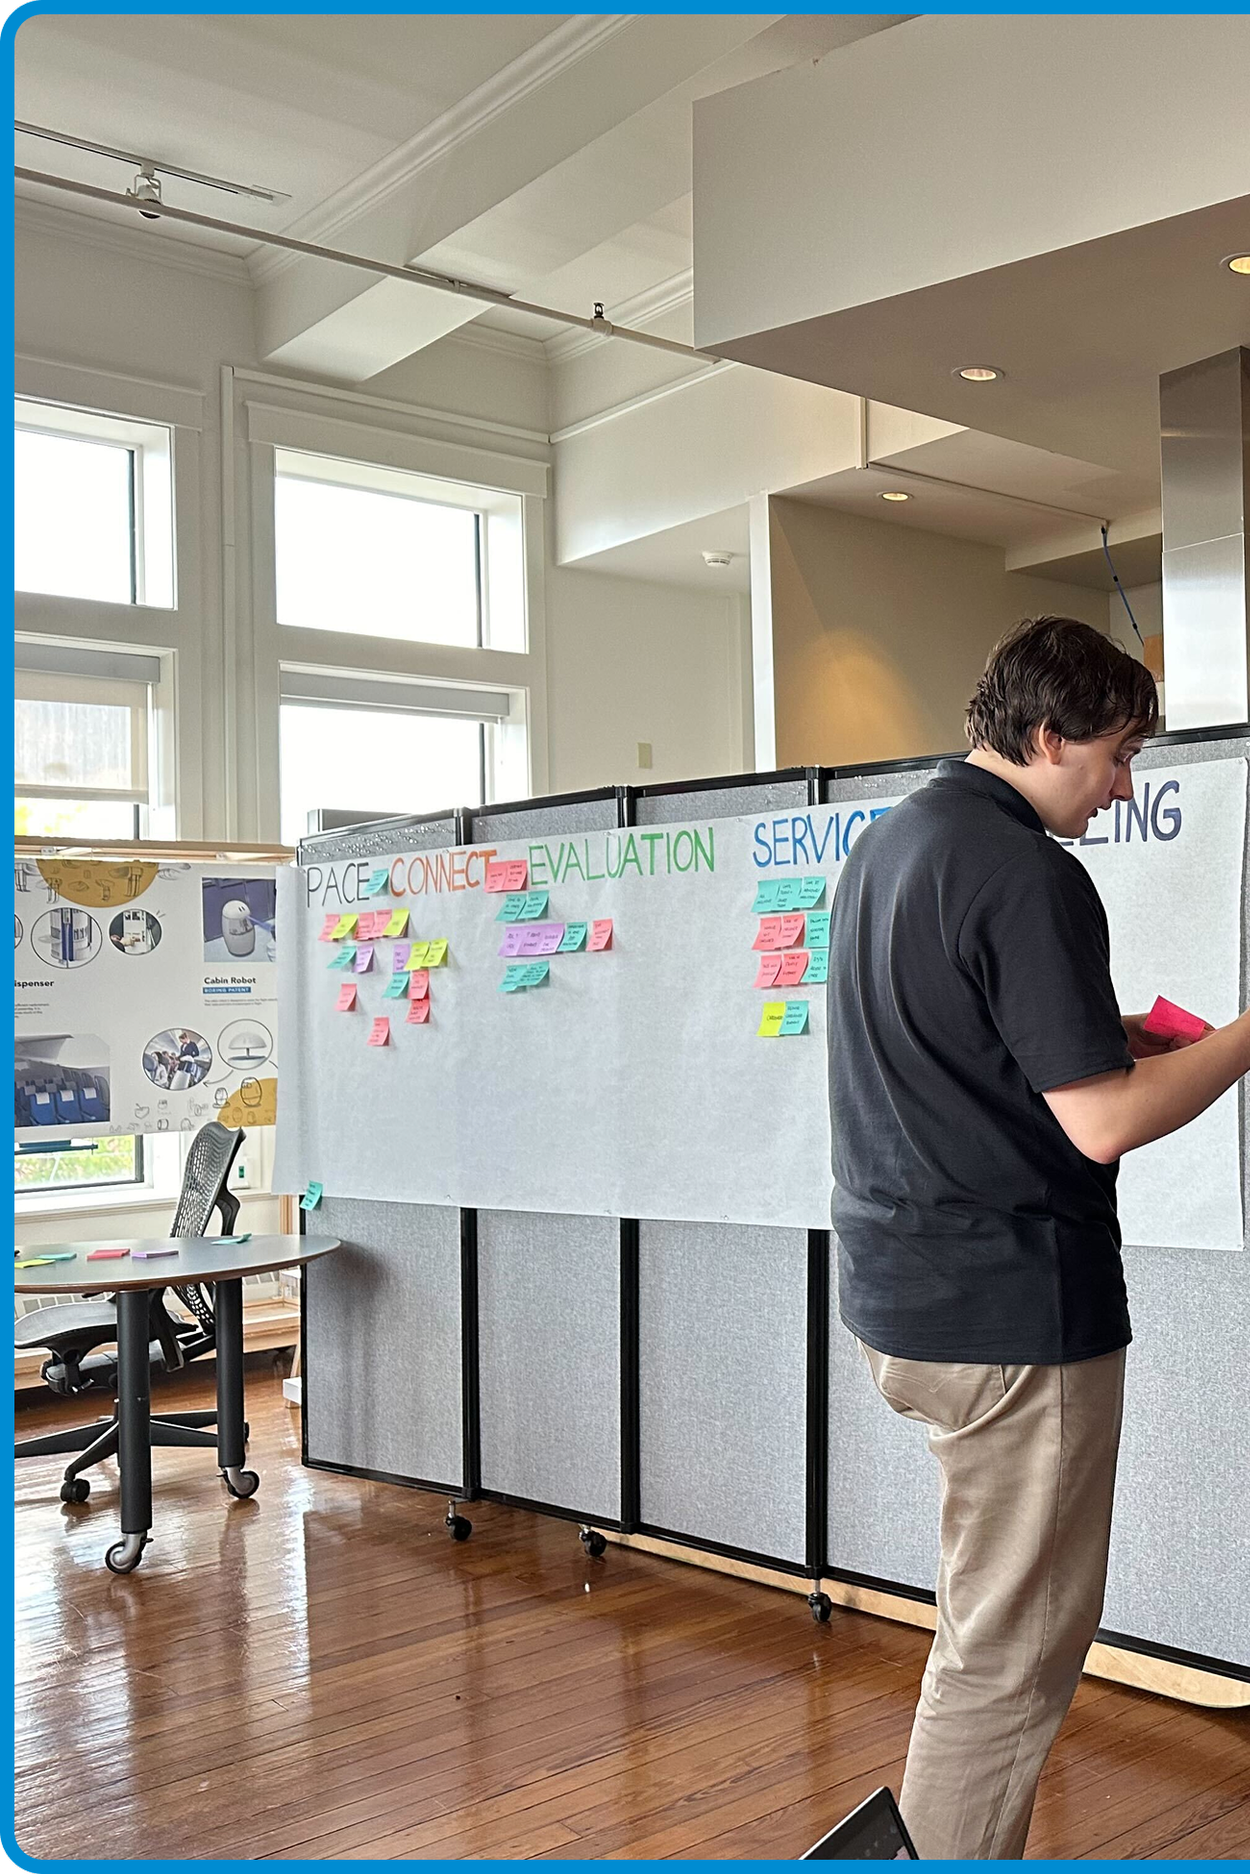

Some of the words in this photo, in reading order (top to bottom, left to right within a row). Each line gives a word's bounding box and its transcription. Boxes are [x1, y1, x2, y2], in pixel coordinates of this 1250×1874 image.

[529, 826, 715, 886] EVALUATION
[753, 806, 893, 868] SERVIC
[307, 861, 370, 908] PACE
[389, 849, 498, 898] CONNECT
[204, 976, 229, 985] Cabin
[231, 975, 257, 984] Robot
